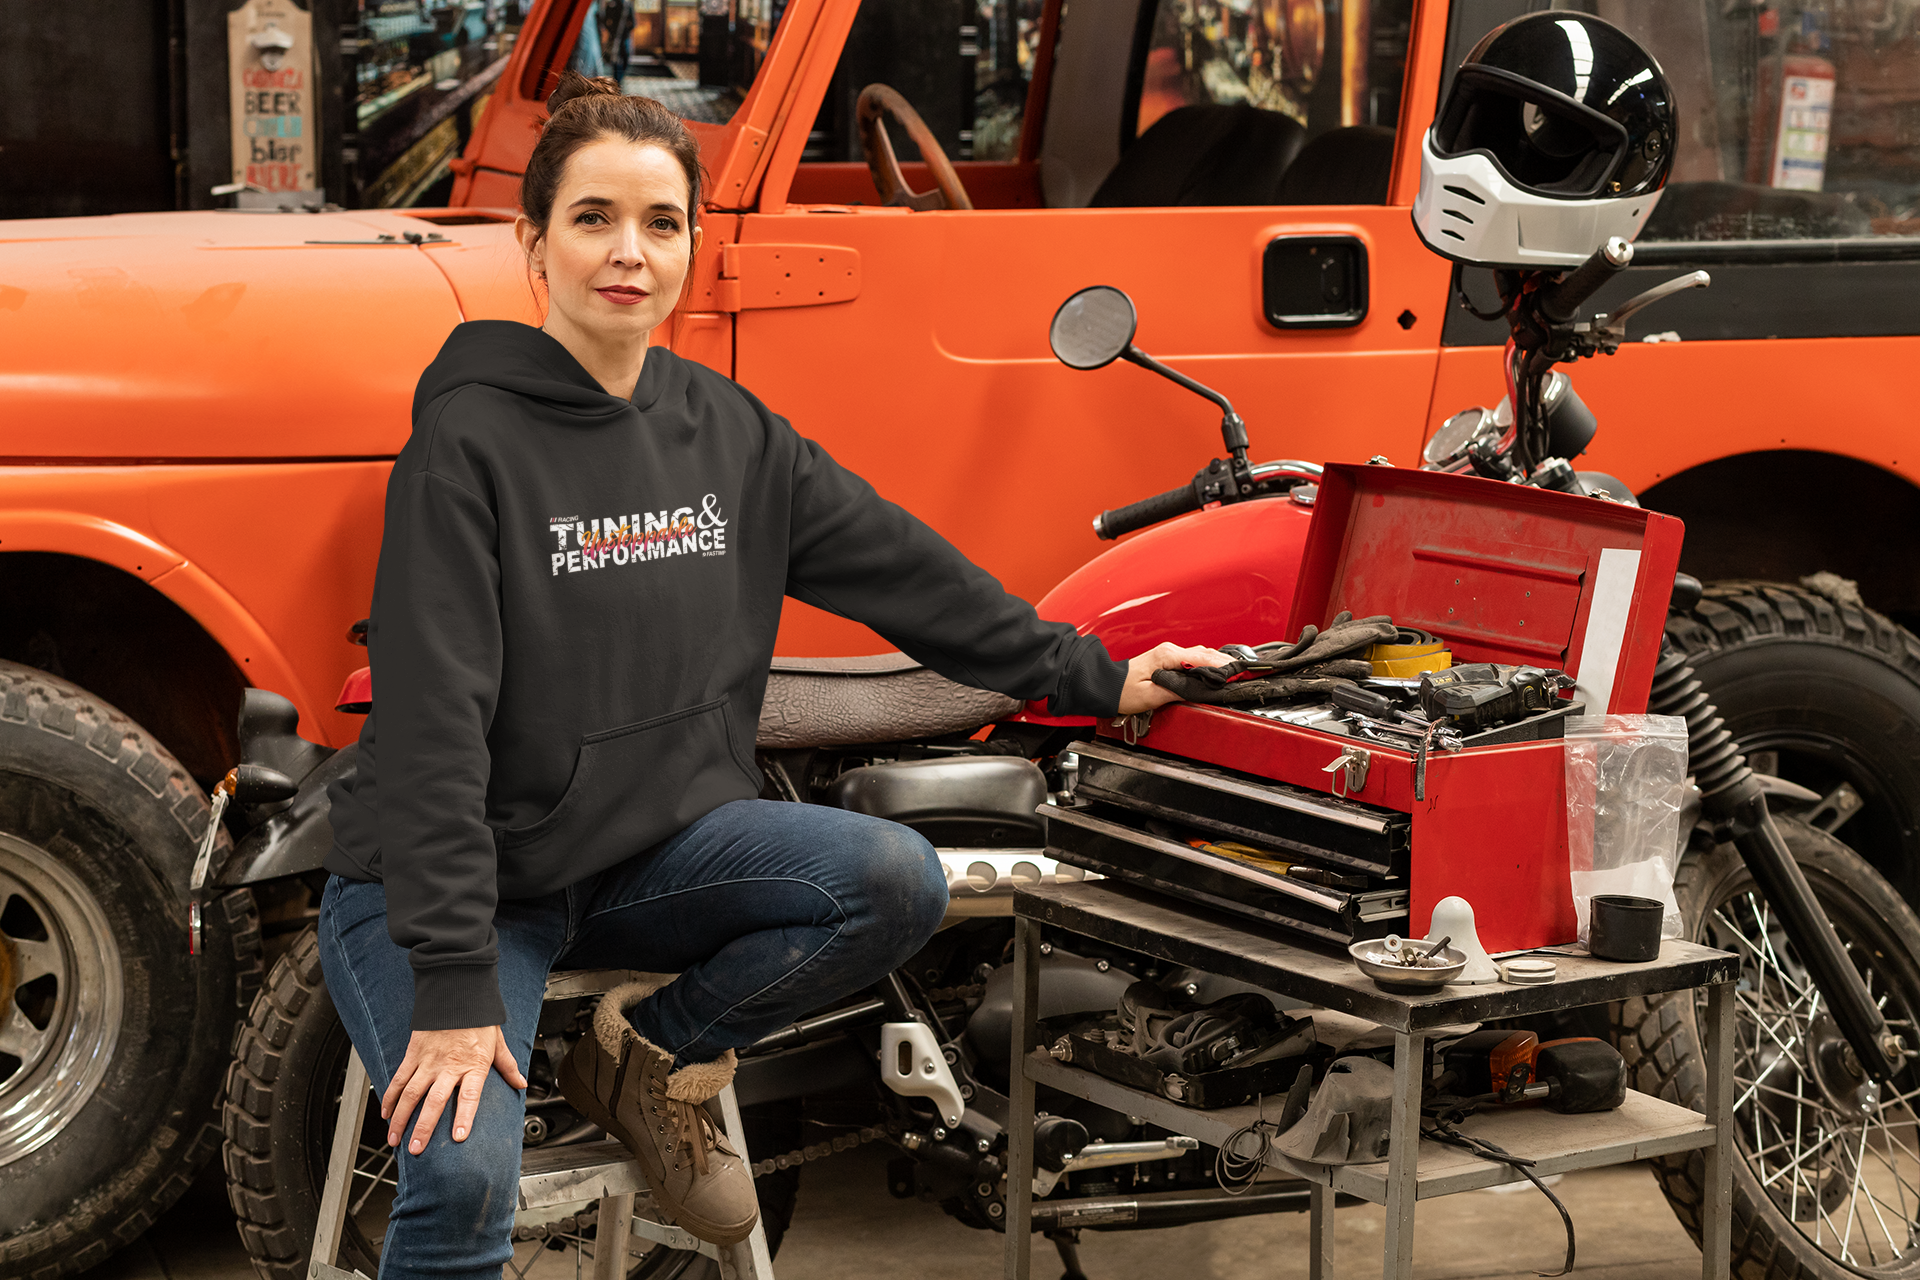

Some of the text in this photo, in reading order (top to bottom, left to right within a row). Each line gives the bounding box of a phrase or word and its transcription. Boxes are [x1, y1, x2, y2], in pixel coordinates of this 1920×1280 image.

[245, 91, 301, 115] BEER
[550, 507, 695, 551] TUNING
[582, 516, 697, 560] Unstoppable
[551, 528, 726, 576] PERFORMANCE
